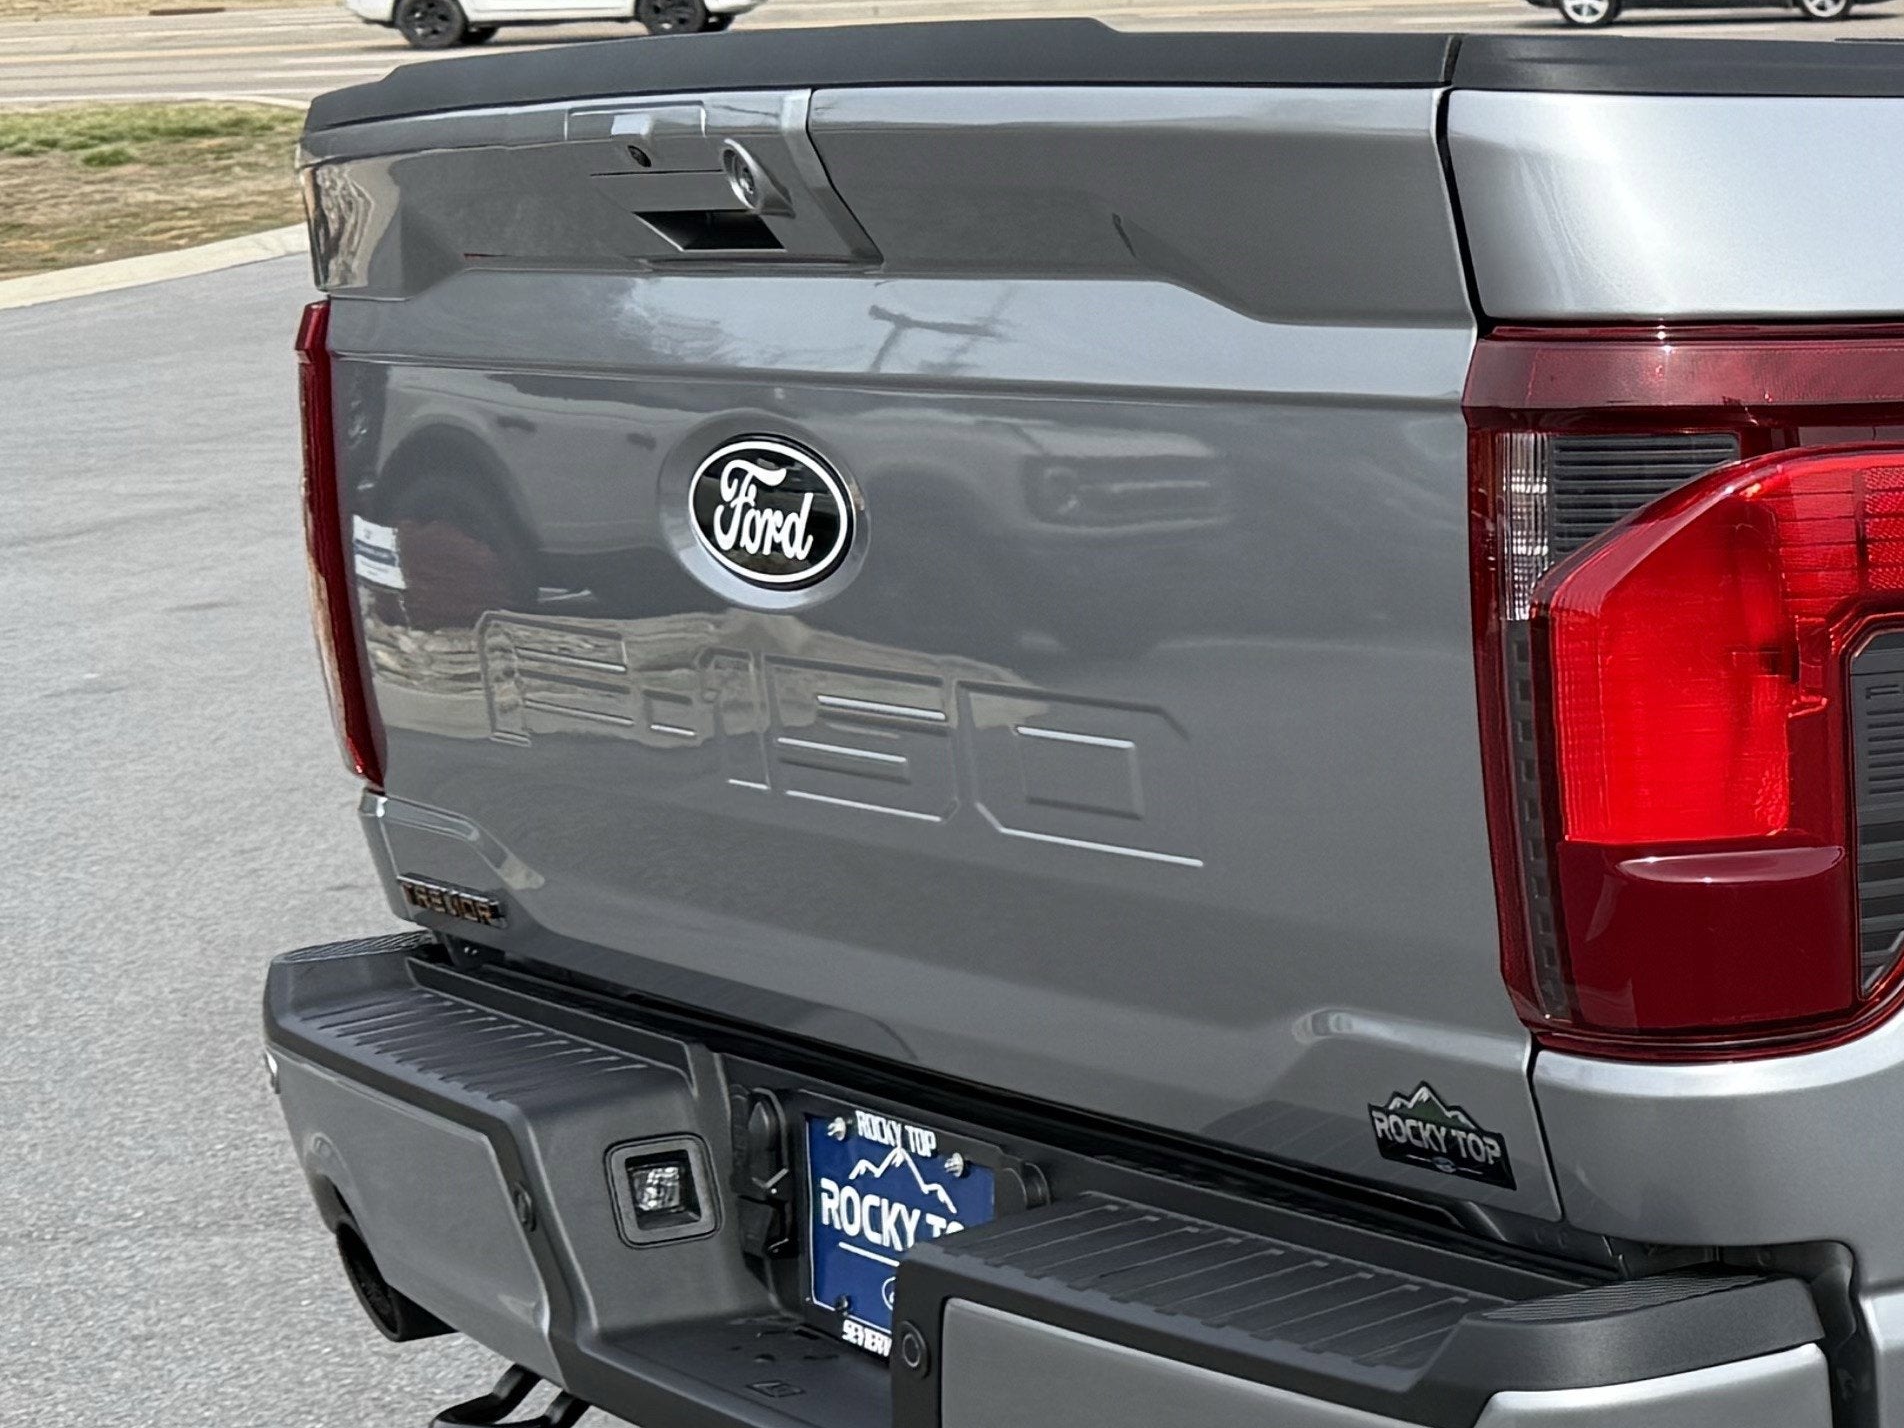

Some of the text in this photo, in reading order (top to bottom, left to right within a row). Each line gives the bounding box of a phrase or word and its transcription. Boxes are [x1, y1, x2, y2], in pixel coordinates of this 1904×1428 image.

[714, 459, 814, 561] Ford
[474, 608, 1206, 868] F-150
[855, 1110, 938, 1158] ROCKY TOP
[1371, 1109, 1502, 1166] ROCKY TOP
[820, 1177, 921, 1252] ROCKY
